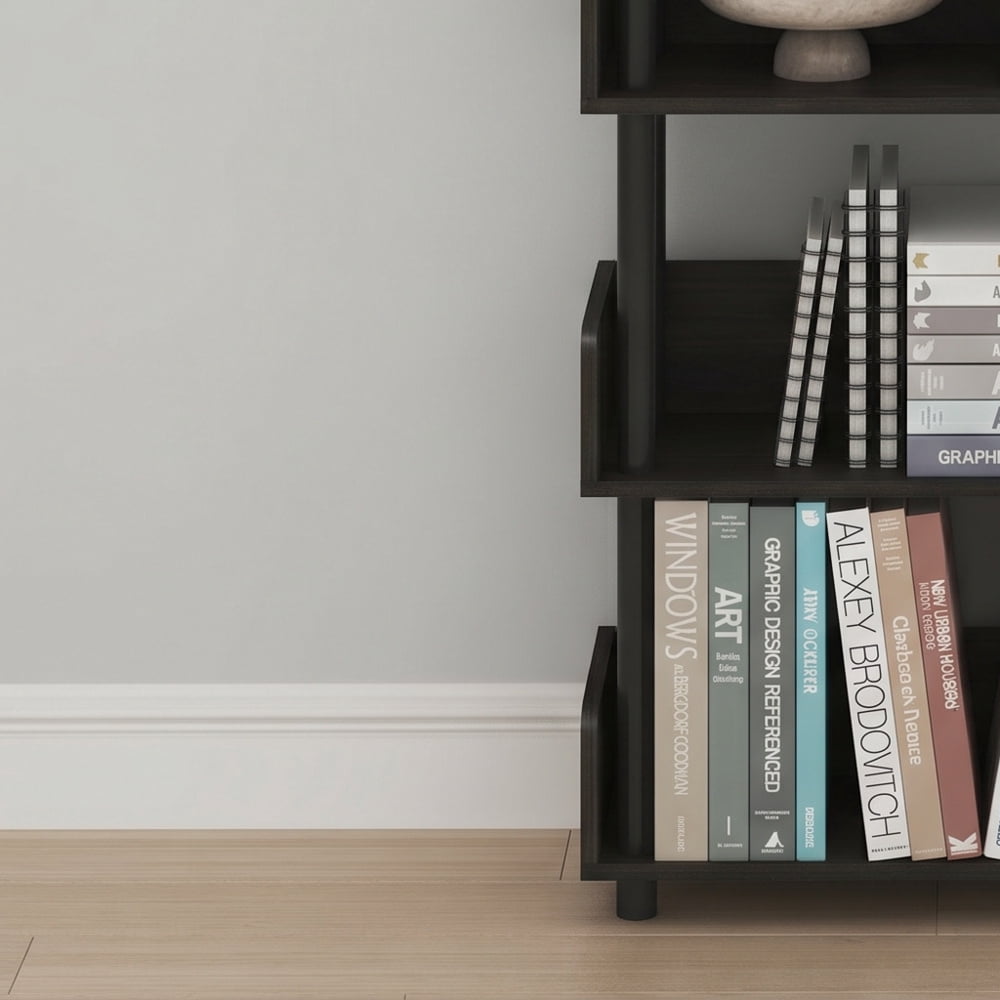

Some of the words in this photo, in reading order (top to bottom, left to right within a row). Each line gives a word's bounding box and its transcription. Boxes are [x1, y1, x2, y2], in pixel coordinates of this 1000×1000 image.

[665, 512, 697, 659] WINDOWS
[714, 586, 743, 645] ART
[833, 521, 876, 633] ALEXEY
[764, 617, 781, 679] DESIGN
[764, 684, 781, 793] REFERENCED
[849, 644, 901, 838] BRODOVITCH
